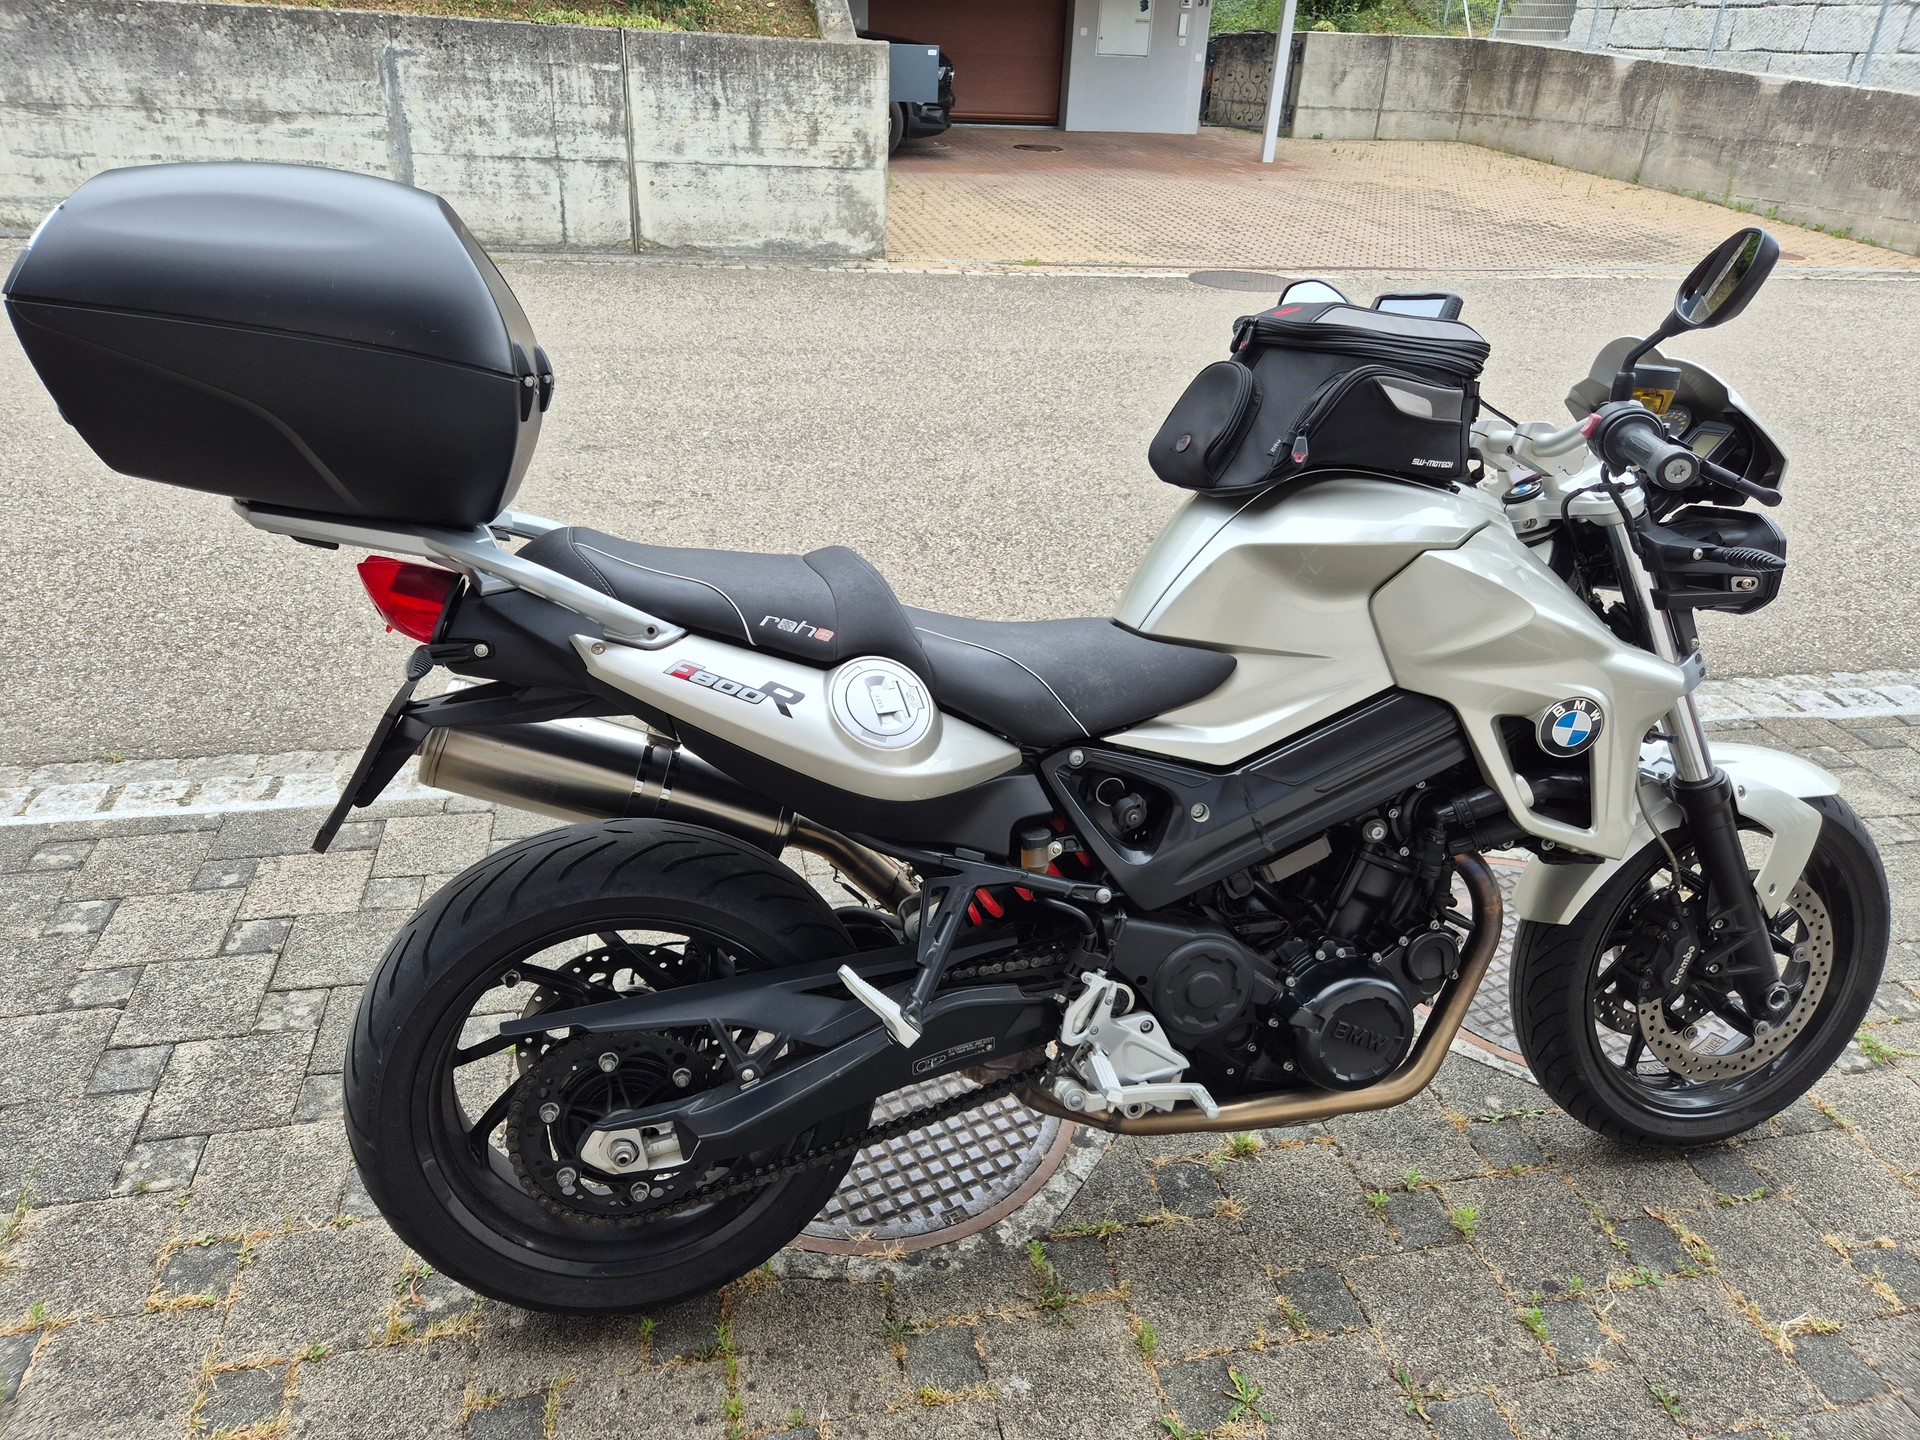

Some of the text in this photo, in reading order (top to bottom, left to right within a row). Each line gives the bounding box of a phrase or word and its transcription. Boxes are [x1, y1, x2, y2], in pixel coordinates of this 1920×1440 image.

[1411, 458, 1453, 468] SW-MOTECH
[1552, 699, 1601, 722] BMW
[1670, 945, 1696, 985] brembo
[1331, 1021, 1389, 1052] BMW
